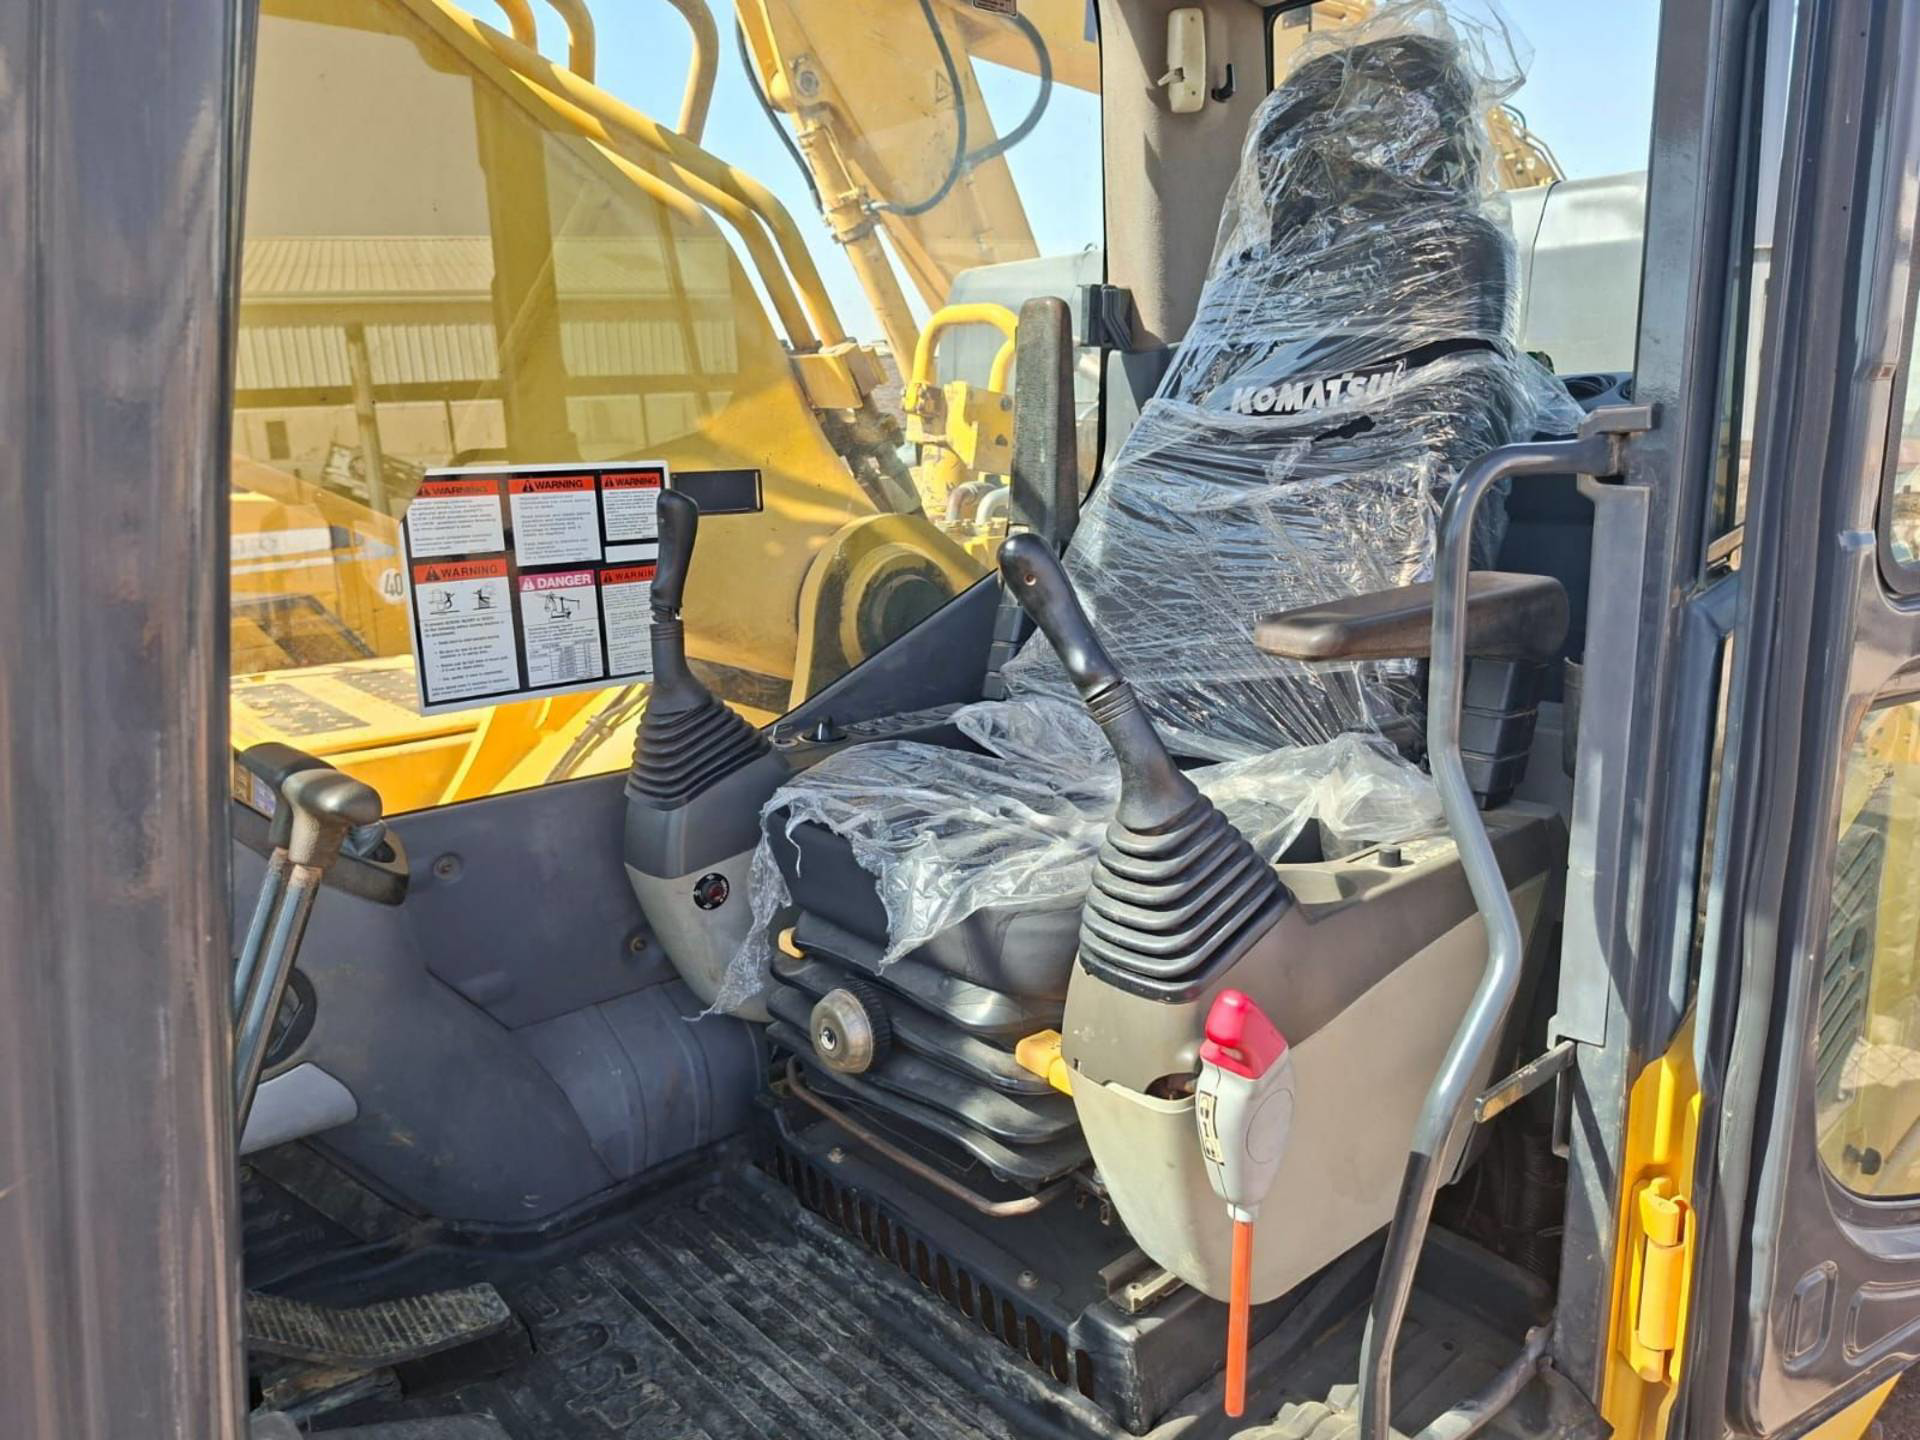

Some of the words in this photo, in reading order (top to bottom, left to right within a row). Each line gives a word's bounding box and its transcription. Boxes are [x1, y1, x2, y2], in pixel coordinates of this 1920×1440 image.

[1231, 371, 1394, 414] KOMATSU
[533, 479, 584, 490] WARNING
[614, 476, 658, 487] WARNING
[440, 565, 498, 578] WARNING
[615, 570, 654, 580] WARNIN
[536, 573, 592, 589] DANGER
